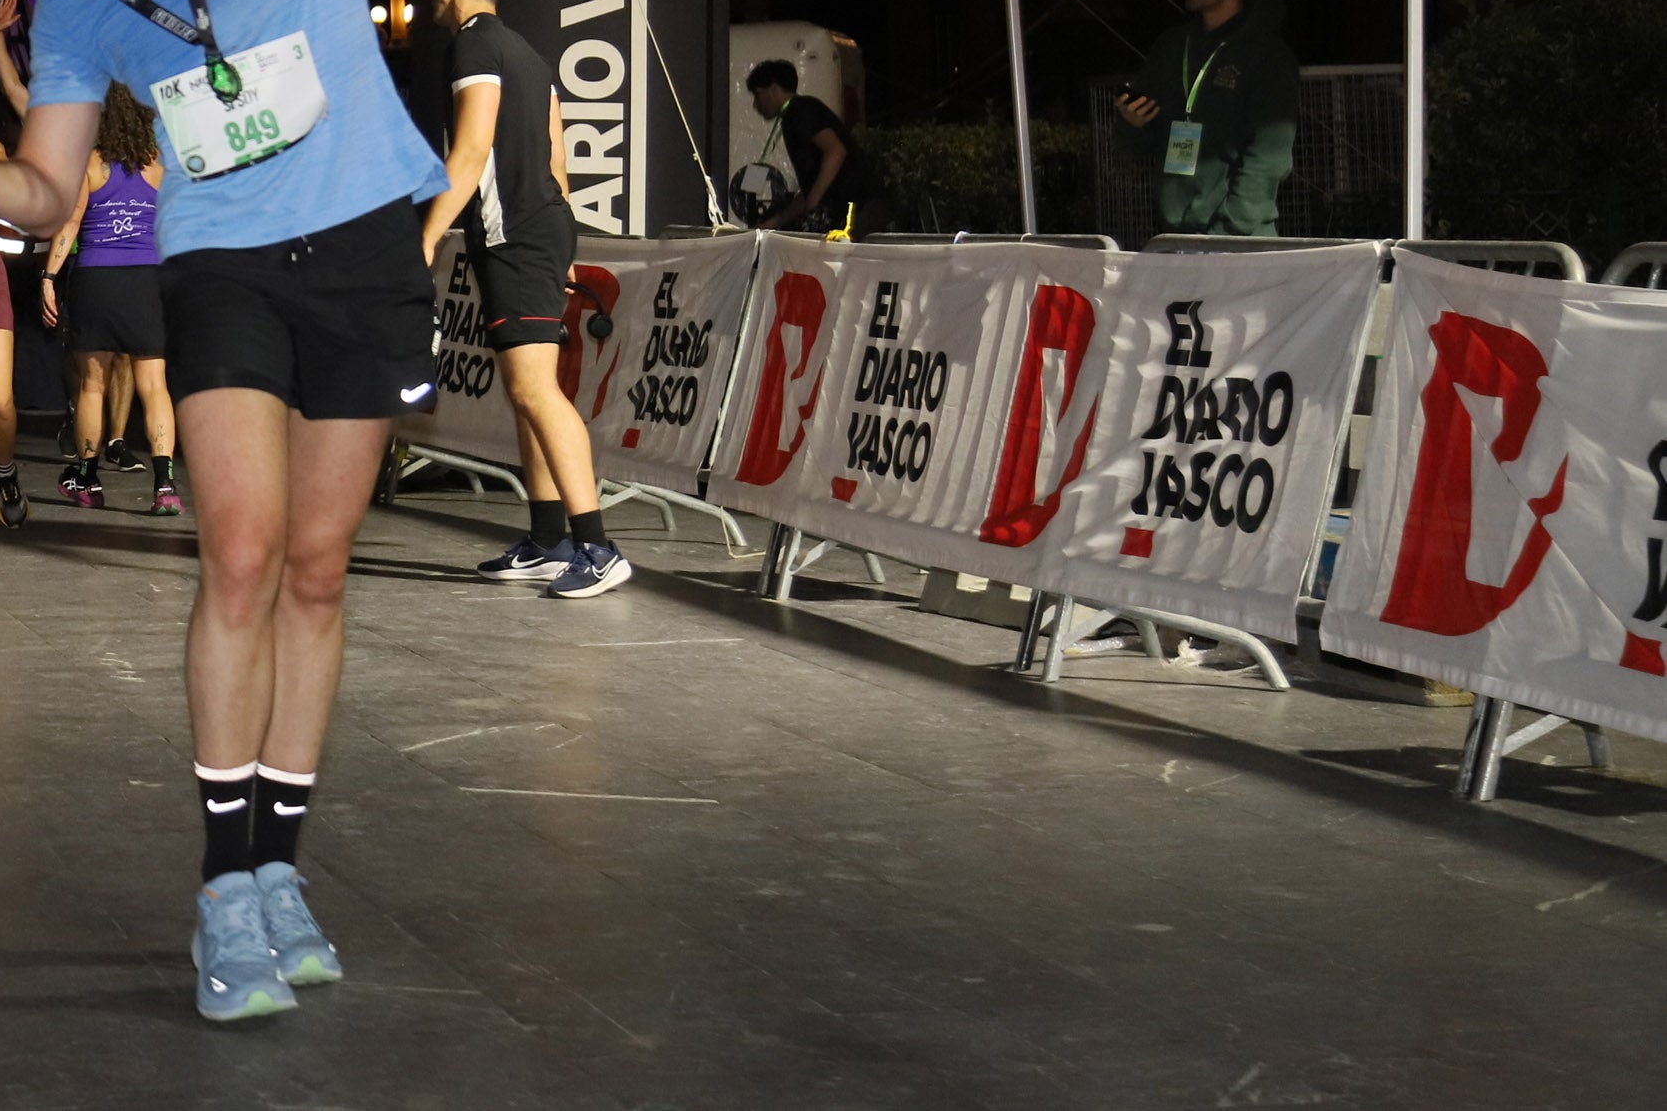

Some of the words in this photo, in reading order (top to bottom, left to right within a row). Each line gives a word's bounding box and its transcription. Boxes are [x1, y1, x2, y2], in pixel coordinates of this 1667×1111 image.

[293, 45, 303, 60] 3
[159, 78, 185, 101] 10K
[224, 109, 280, 152] 849
[654, 272, 679, 319] EL
[869, 281, 900, 340] EL
[1165, 300, 1213, 368] EL
[855, 345, 948, 413] DIARIO
[847, 411, 932, 483] VASCO
